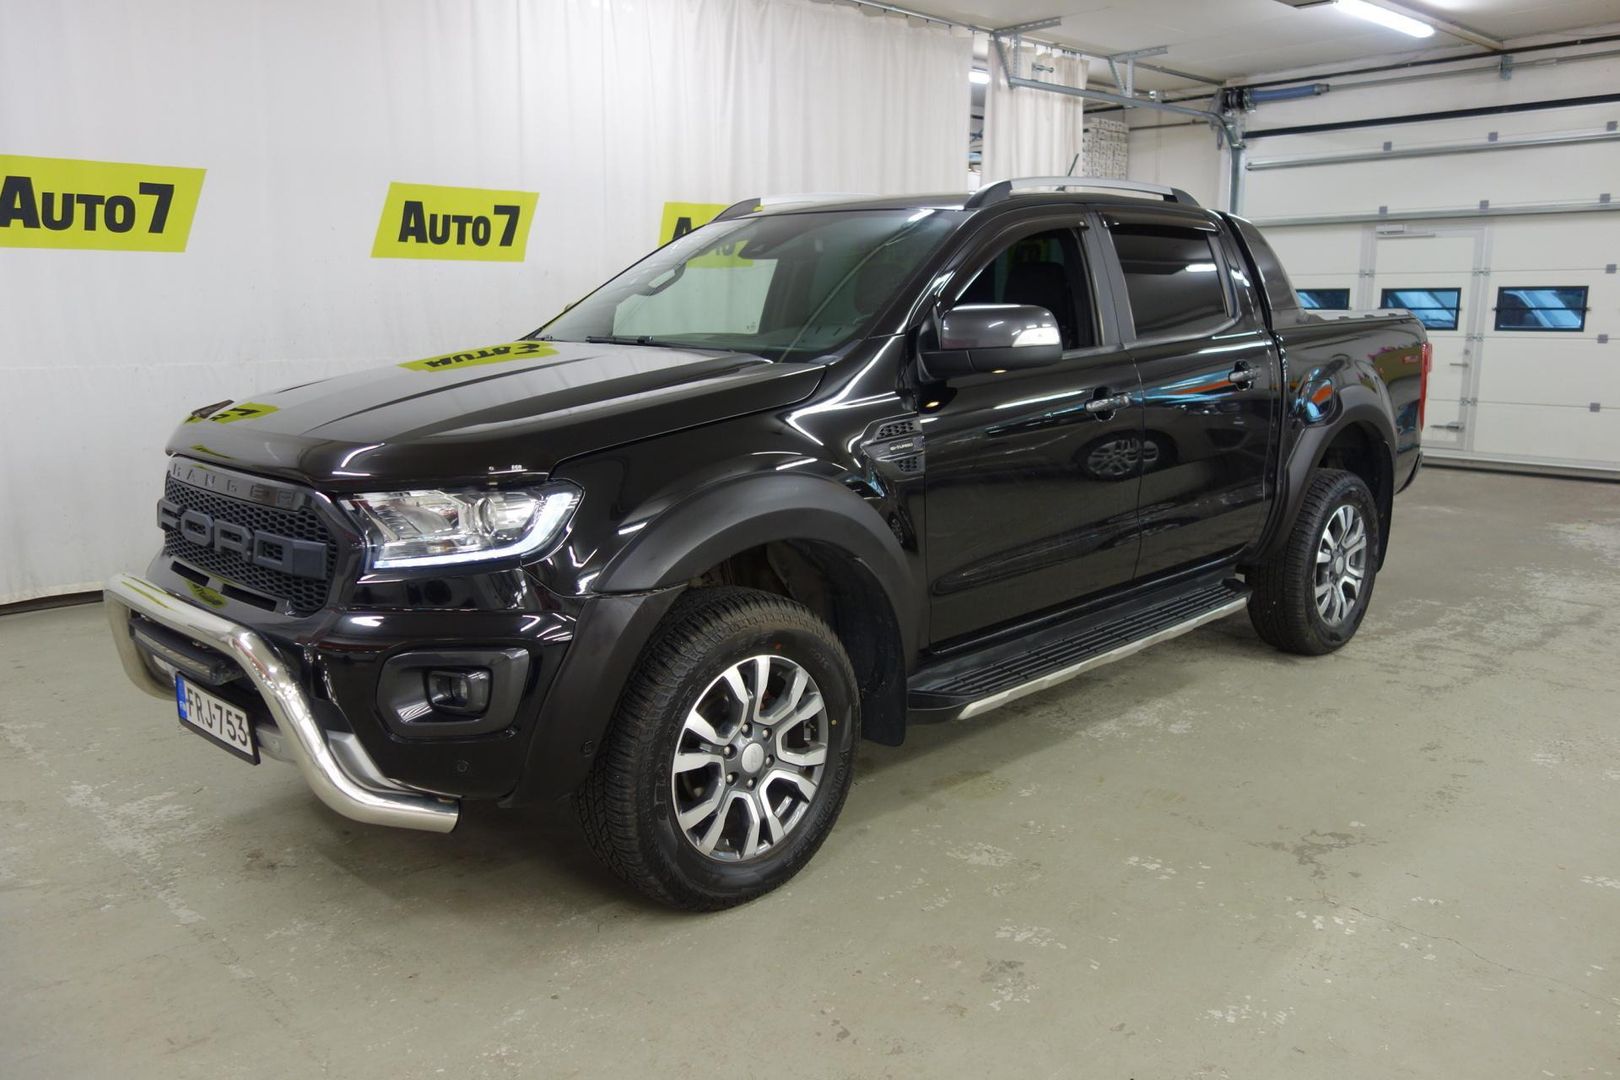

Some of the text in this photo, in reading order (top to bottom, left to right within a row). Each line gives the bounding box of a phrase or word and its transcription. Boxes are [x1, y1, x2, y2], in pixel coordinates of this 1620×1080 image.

[172, 462, 295, 505] RANGER
[157, 499, 327, 579] FORD
[187, 687, 247, 747] FRJ-753
